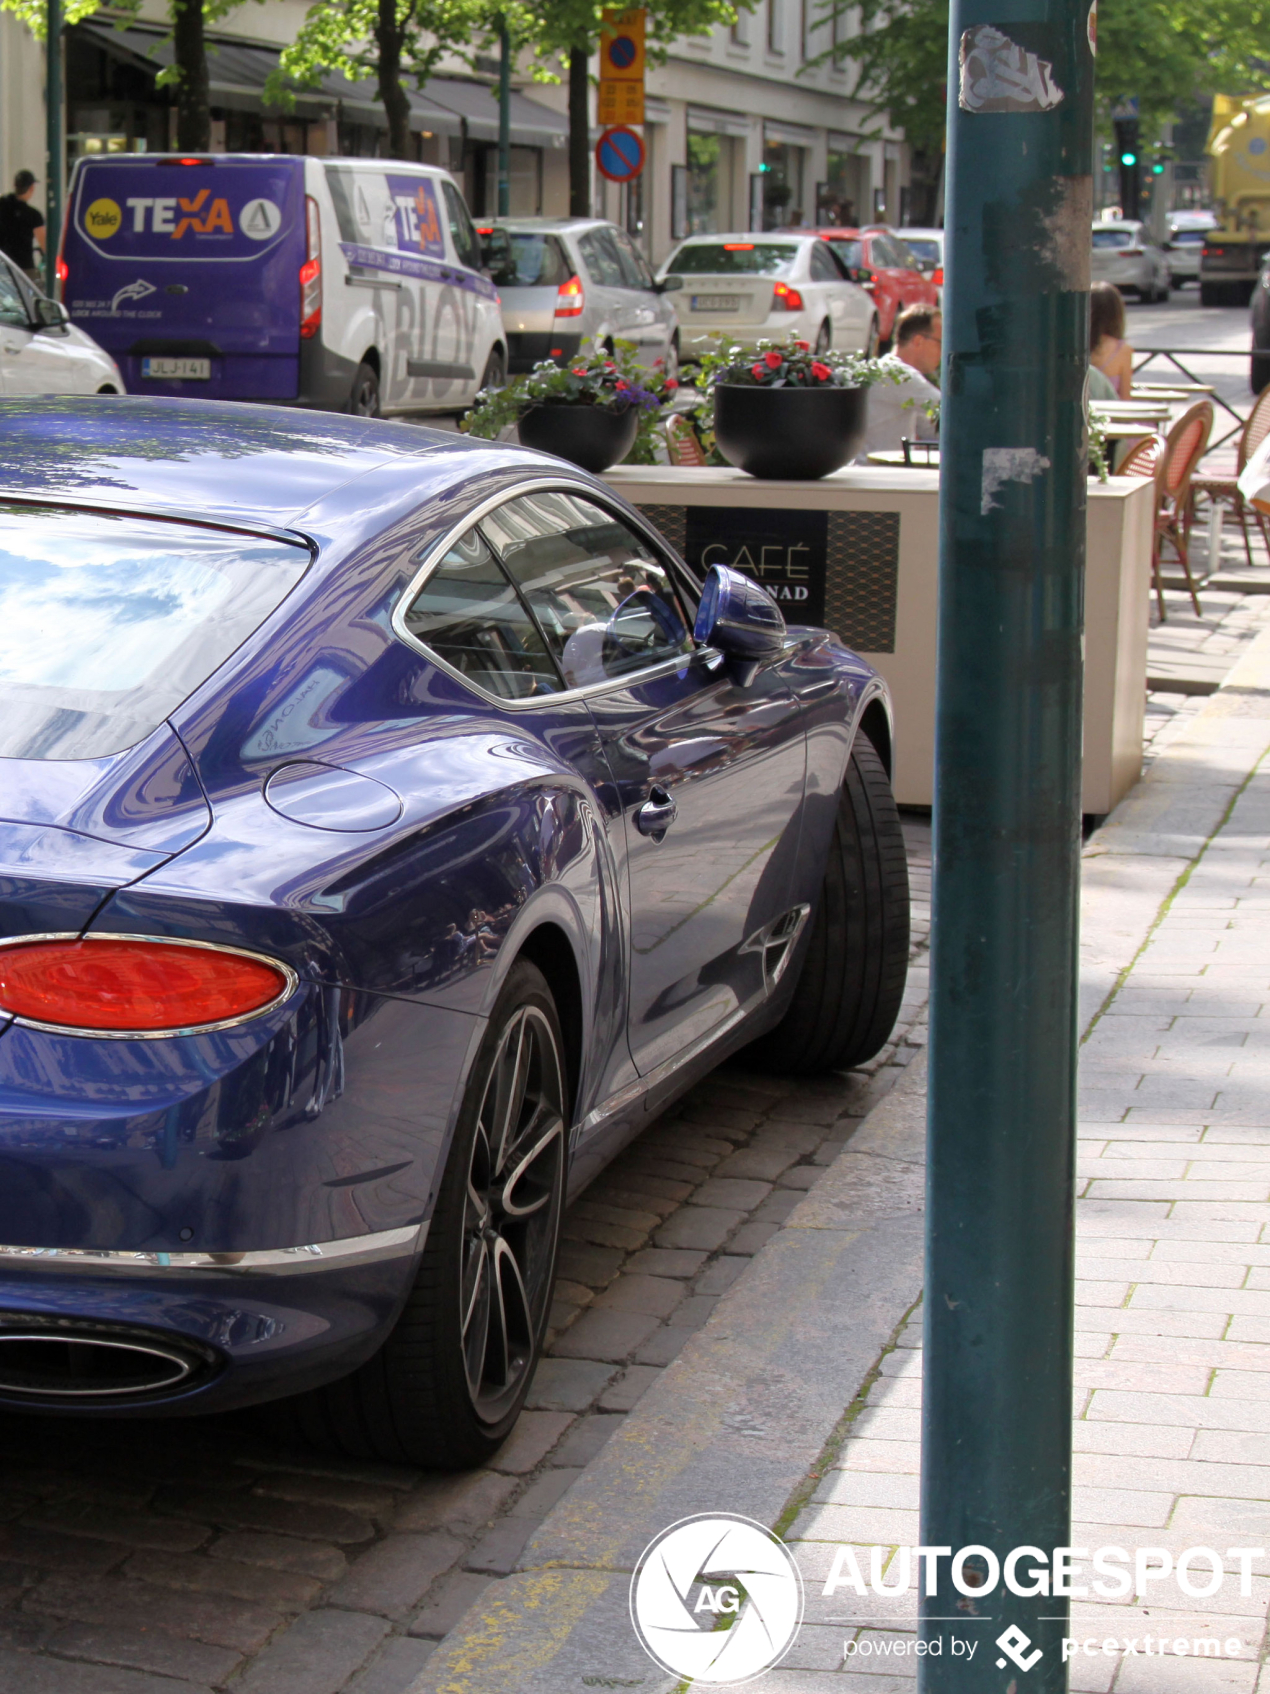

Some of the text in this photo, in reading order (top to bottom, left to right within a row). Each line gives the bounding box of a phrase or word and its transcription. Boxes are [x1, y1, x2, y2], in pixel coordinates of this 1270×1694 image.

[90, 211, 117, 226] Yale
[126, 189, 234, 239] TEXA
[394, 186, 441, 250] TEXA
[123, 310, 136, 318] THE
[372, 283, 479, 401] ABLOY
[701, 541, 810, 579] CAFÉ
[766, 585, 809, 600] NAD
